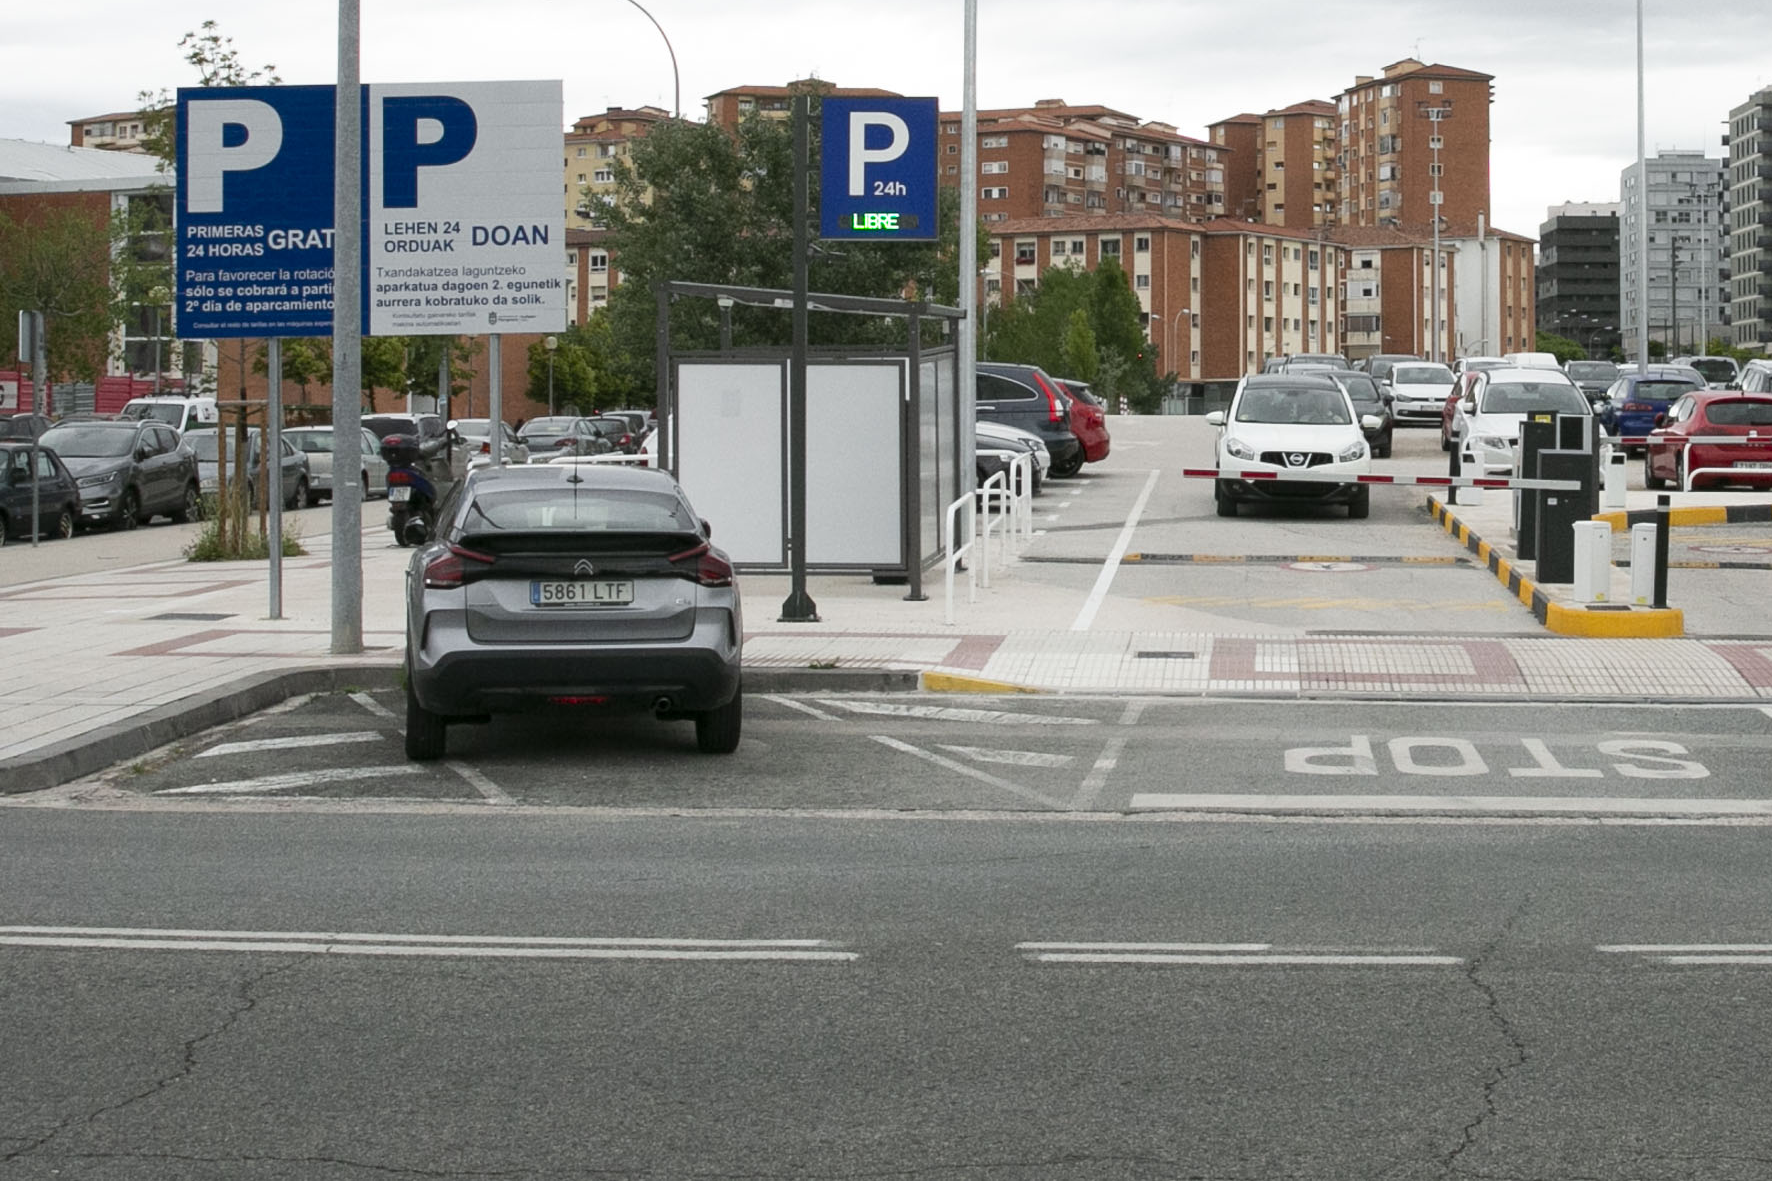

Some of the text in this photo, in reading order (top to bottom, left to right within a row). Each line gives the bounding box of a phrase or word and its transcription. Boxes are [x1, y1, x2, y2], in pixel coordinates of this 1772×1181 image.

[187, 99, 283, 213] P
[383, 95, 478, 208] P
[849, 111, 910, 196] P
[873, 181, 907, 196] 24h
[384, 221, 461, 235] LEHEN 24
[853, 213, 900, 230] LIBRE
[187, 225, 264, 238] PRIMERAS
[472, 224, 549, 246] DOAN
[268, 229, 335, 250] GRAT
[384, 239, 455, 253] ORDUAK
[187, 243, 264, 257] 24 HORAS
[185, 268, 335, 282] Para favorecer la rotació
[376, 265, 526, 279] Txandakatzea laguntzeko
[185, 283, 335, 298] sólo se cobrará a parti
[376, 281, 438, 294] aparkatua
[441, 280, 488, 294] dagoen
[506, 278, 561, 293] egunetik
[202, 300, 222, 312] día
[226, 299, 242, 311] de
[245, 299, 335, 313] aparcamiento
[376, 294, 545, 308] aurrera kobratuko da solik.
[543, 583, 626, 600] 5861 LTF
[1284, 735, 1711, 779] STOP
